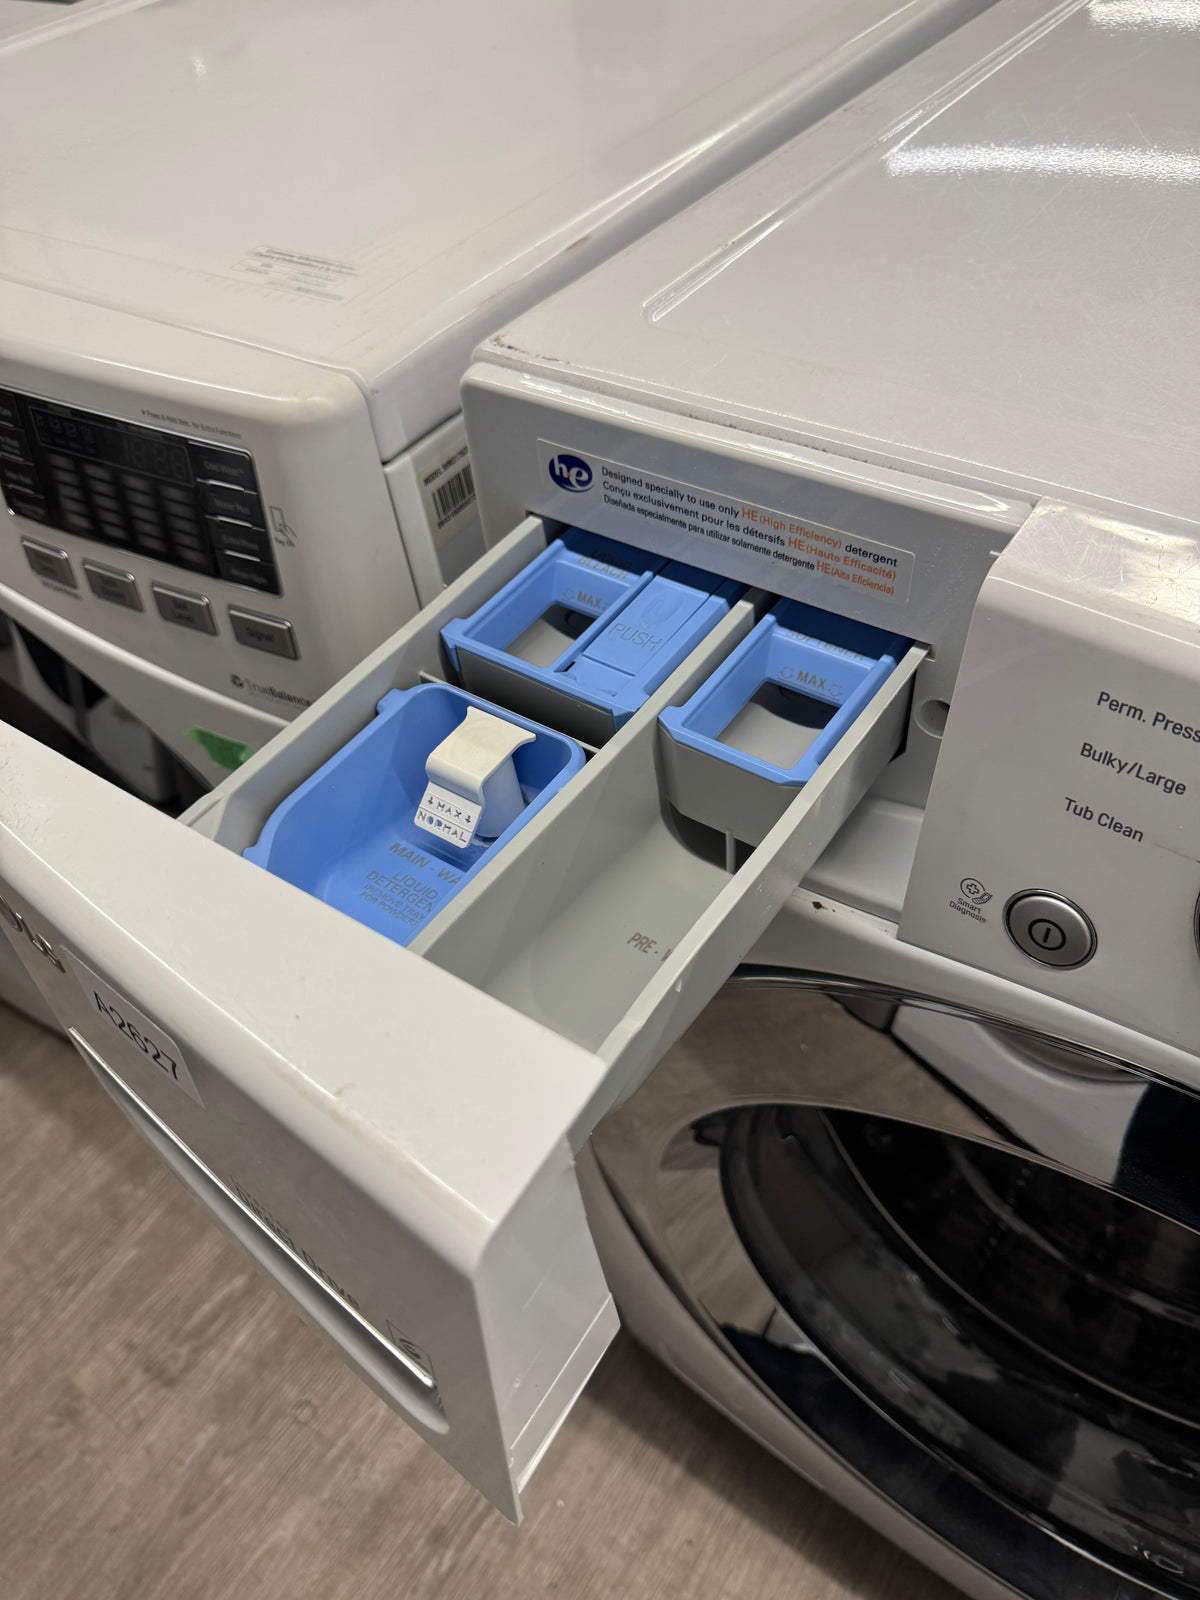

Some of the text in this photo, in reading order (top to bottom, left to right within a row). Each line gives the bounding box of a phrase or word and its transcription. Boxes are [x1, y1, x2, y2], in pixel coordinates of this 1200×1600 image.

[601, 466, 643, 488] Designed
[645, 482, 684, 501] specially
[687, 494, 697, 504] to
[699, 499, 716, 510] use
[718, 503, 740, 519] only
[789, 523, 842, 549] Efficiency)
[845, 542, 898, 568] detergent
[603, 481, 631, 498] Conçu
[633, 491, 699, 520] exclusivement
[701, 513, 724, 527] pour
[726, 519, 740, 532] les
[743, 524, 785, 547] détersifs
[843, 555, 897, 581] Efficacité)
[604, 494, 636, 513] Diseñada
[637, 505, 687, 529] especialmente
[688, 523, 705, 536] para
[706, 526, 730, 542] utilizar
[731, 536, 772, 556] solamente
[772, 550, 815, 571] detergente
[852, 574, 895, 596] Eficiencia)
[577, 556, 629, 580] BLEACH
[577, 591, 602, 609] MAX
[609, 622, 662, 651] PUSH
[797, 670, 827, 690] MAX
[1097, 691, 1200, 743] Perm. Press
[1080, 742, 1187, 795] Bulky/Large
[436, 801, 462, 820] MAX
[1065, 797, 1144, 842] Tub Clean
[417, 811, 467, 843] NORMAL
[388, 842, 431, 868] MAIN
[392, 871, 439, 900] LIQUID
[360, 891, 418, 928] FOR POWDER)
[404, 903, 425, 922] TRAY
[949, 900, 987, 924] Diagnosis
[957, 897, 982, 914] Smart
[93, 990, 179, 1080] A2627
